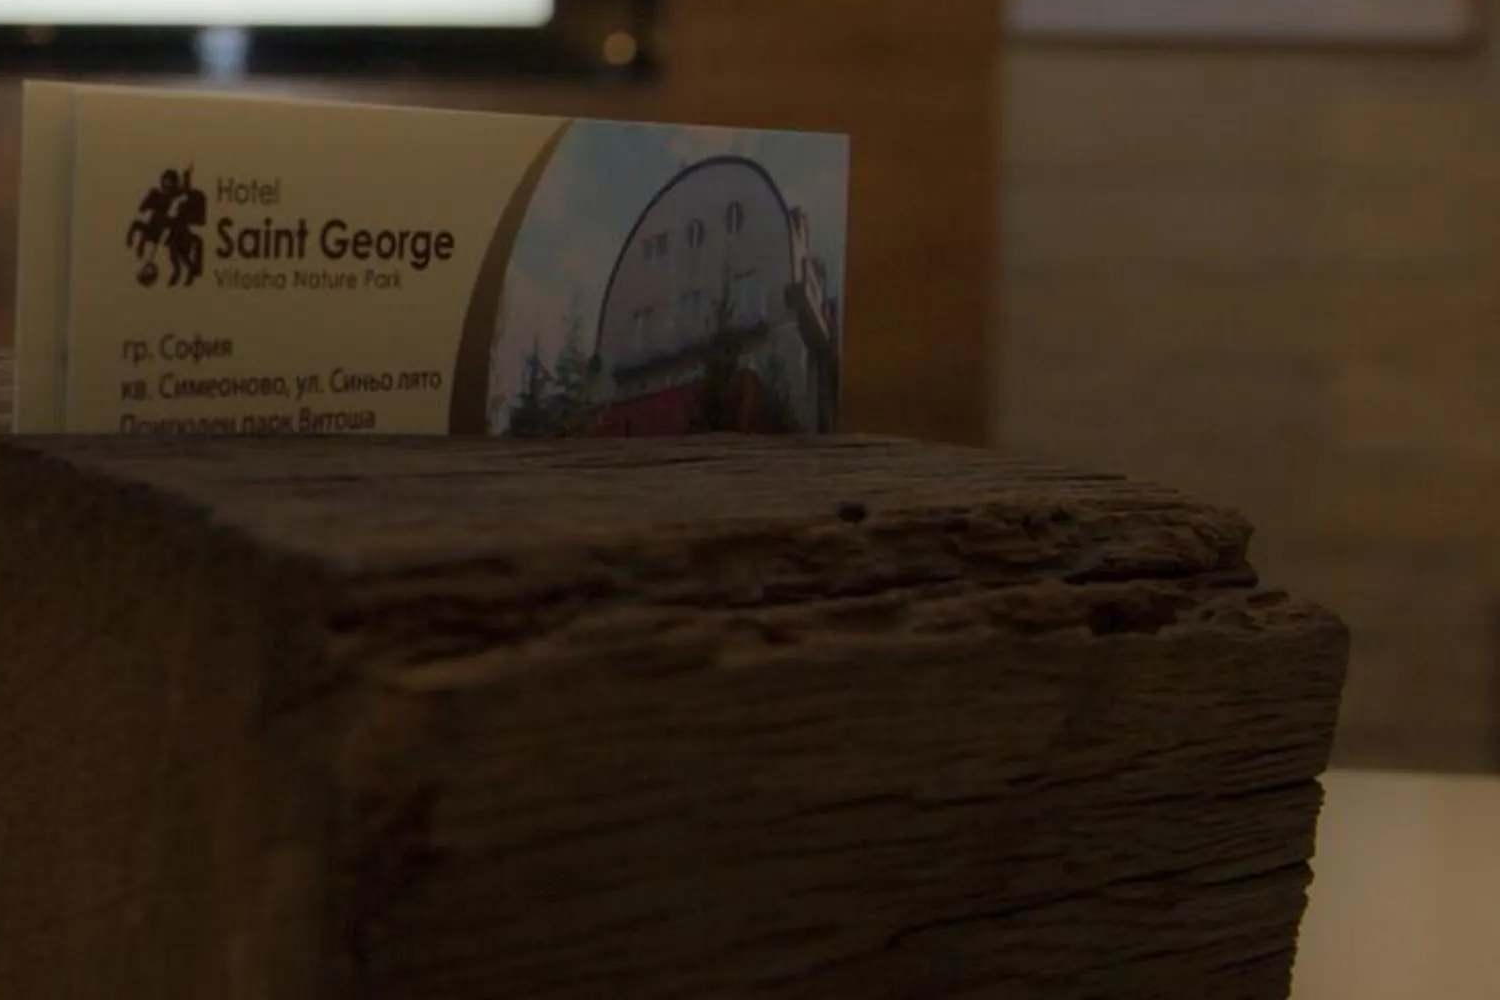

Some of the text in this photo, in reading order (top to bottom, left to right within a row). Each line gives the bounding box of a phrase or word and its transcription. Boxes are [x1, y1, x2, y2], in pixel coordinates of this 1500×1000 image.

[216, 177, 281, 204] Hotel
[216, 217, 454, 271] Saint George
[215, 268, 402, 289] Vitosha Nature Park
[121, 334, 234, 364] гр. София
[296, 375, 324, 401] ул.
[330, 368, 393, 394] Синьо
[397, 369, 442, 391] лято
